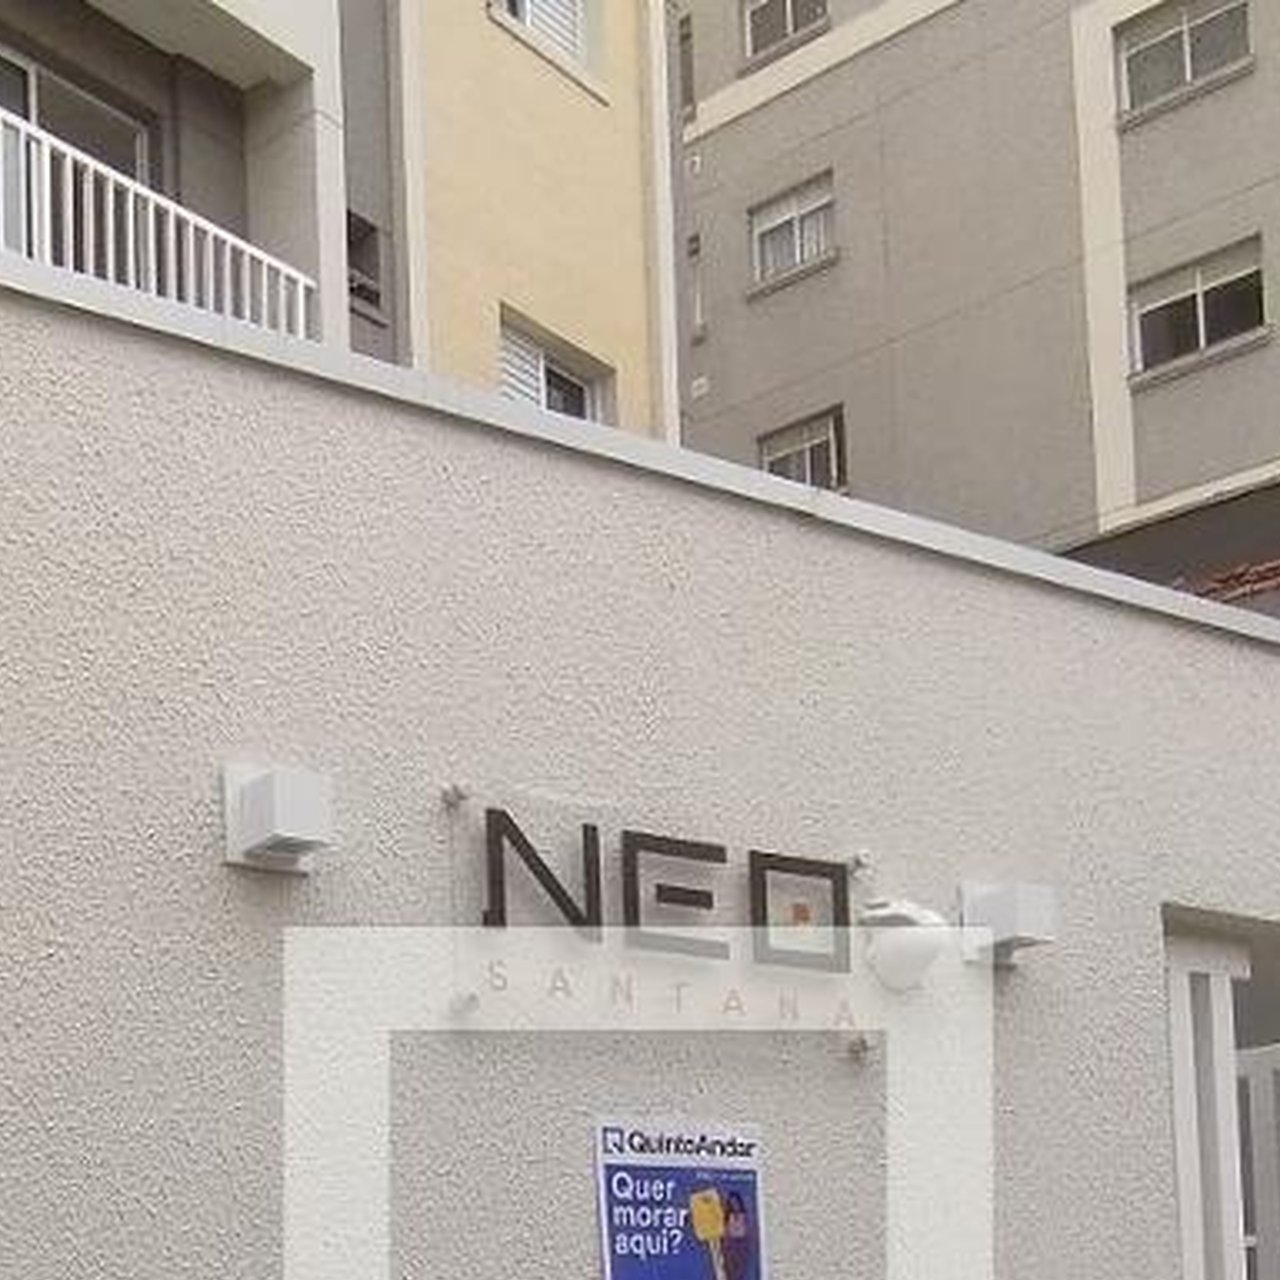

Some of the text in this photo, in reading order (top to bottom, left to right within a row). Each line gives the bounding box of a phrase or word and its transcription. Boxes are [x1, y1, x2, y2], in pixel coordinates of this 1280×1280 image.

[482, 807, 851, 973] NEO
[486, 958, 857, 1028] SANTANA
[628, 1130, 757, 1157] QuintoAndar
[611, 1171, 675, 1200] Quer
[612, 1206, 687, 1228] morar
[614, 1229, 683, 1260] aqui?
